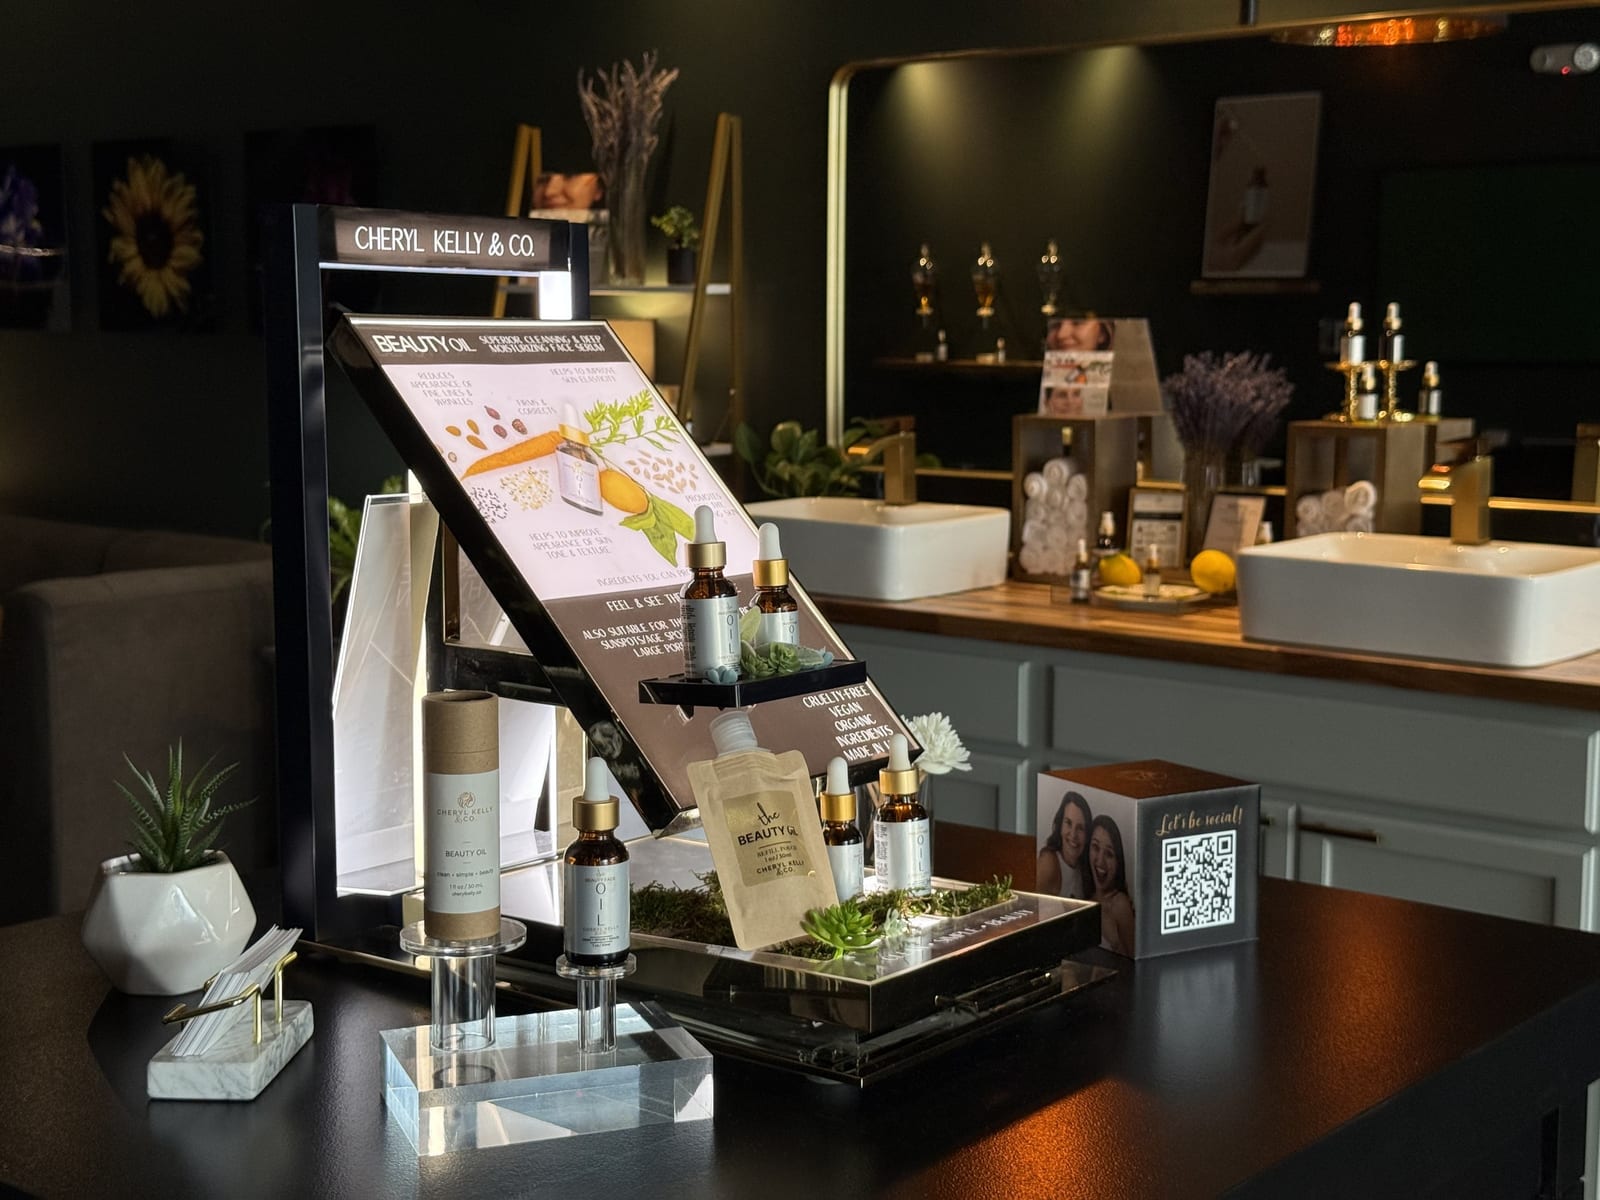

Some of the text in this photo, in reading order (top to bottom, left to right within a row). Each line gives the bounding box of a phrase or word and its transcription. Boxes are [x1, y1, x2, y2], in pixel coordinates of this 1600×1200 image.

[355, 225, 535, 257] CHERYL KELLY & CO.
[371, 335, 477, 353] BEAUTY OIL
[478, 335, 521, 345] SUPERIOR
[524, 335, 571, 344] CLEANSING
[579, 335, 601, 344] DEEP
[488, 344, 549, 353] MOISTURIZING
[550, 343, 575, 352] FACE
[529, 527, 604, 541] HELPS TO IMPROVE
[533, 539, 581, 551] APPEARANCE
[545, 550, 569, 560] TONE
[578, 545, 612, 557] TEXTURE
[597, 574, 643, 587] INGREDIENTS
[660, 570, 676, 580] CAN
[606, 599, 634, 612] FEEL
[634, 598, 644, 608] &
[644, 595, 664, 607] SEE
[582, 628, 607, 640] ALSO
[607, 622, 649, 637] SUITABLE
[648, 620, 669, 631] FOR
[600, 632, 664, 650] SUNSPOTS/AGE
[633, 644, 664, 658] LARGE
[802, 685, 870, 708] CRUELTY-FREE
[828, 701, 863, 718] VEGAN
[834, 713, 877, 732] ORGANIC
[835, 724, 894, 748] INGREDIENTS
[843, 744, 873, 761] MADE
[871, 742, 885, 754] IN
[436, 806, 493, 816] CHERYL KELLY
[757, 801, 780, 826] the
[1155, 804, 1243, 836] Let's be social!
[737, 825, 784, 846] BEAUTY
[445, 848, 487, 858] BEAUTY OIL
[756, 862, 787, 874] CHERYL
[595, 882, 606, 927] OIL
